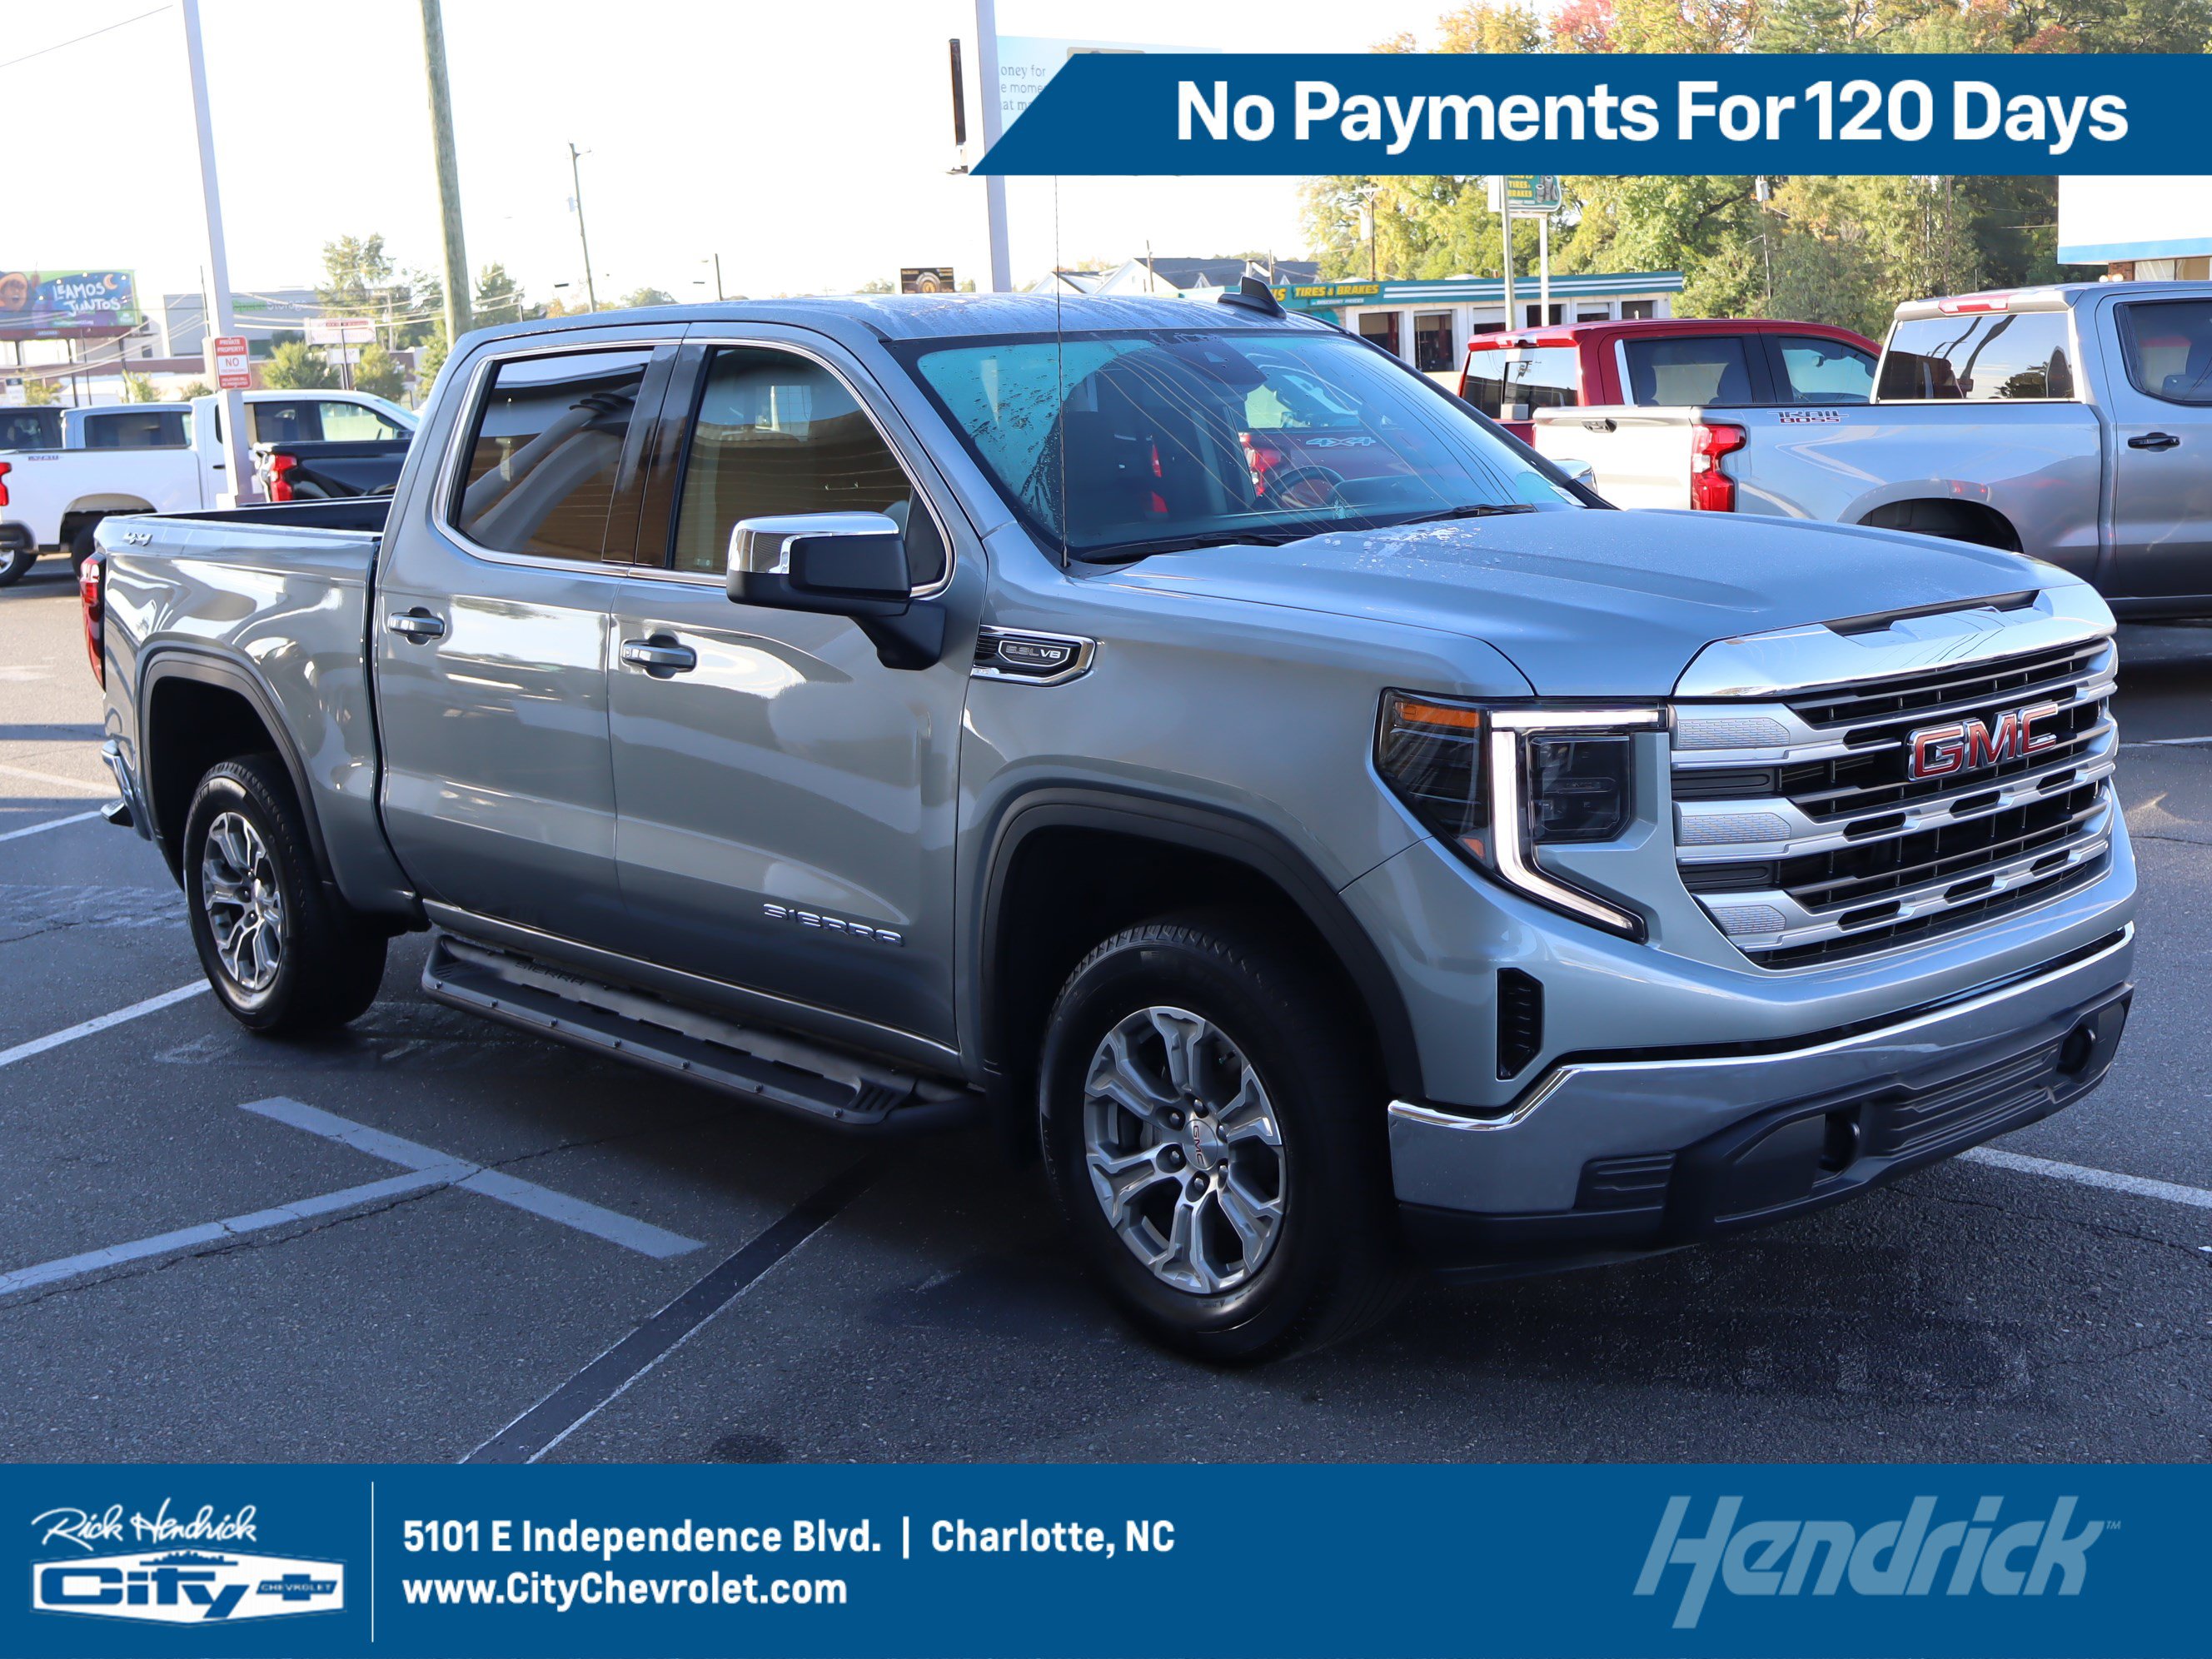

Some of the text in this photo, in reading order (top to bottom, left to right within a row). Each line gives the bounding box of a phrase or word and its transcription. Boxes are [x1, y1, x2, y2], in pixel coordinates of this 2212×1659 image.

[1000, 64, 1046, 79] oney for
[53, 281, 106, 301] LEAMOS
[1294, 286, 1327, 297] TIRES
[1336, 284, 1380, 296] BRAKES
[63, 296, 121, 317] JUNTOS
[226, 357, 240, 366] NO
[1767, 410, 1849, 418] TRAIL
[1040, 649, 1062, 659] V8
[1908, 703, 2059, 782] GMC
[763, 903, 905, 947] SIERRA
[1193, 1124, 1205, 1166] GMC
